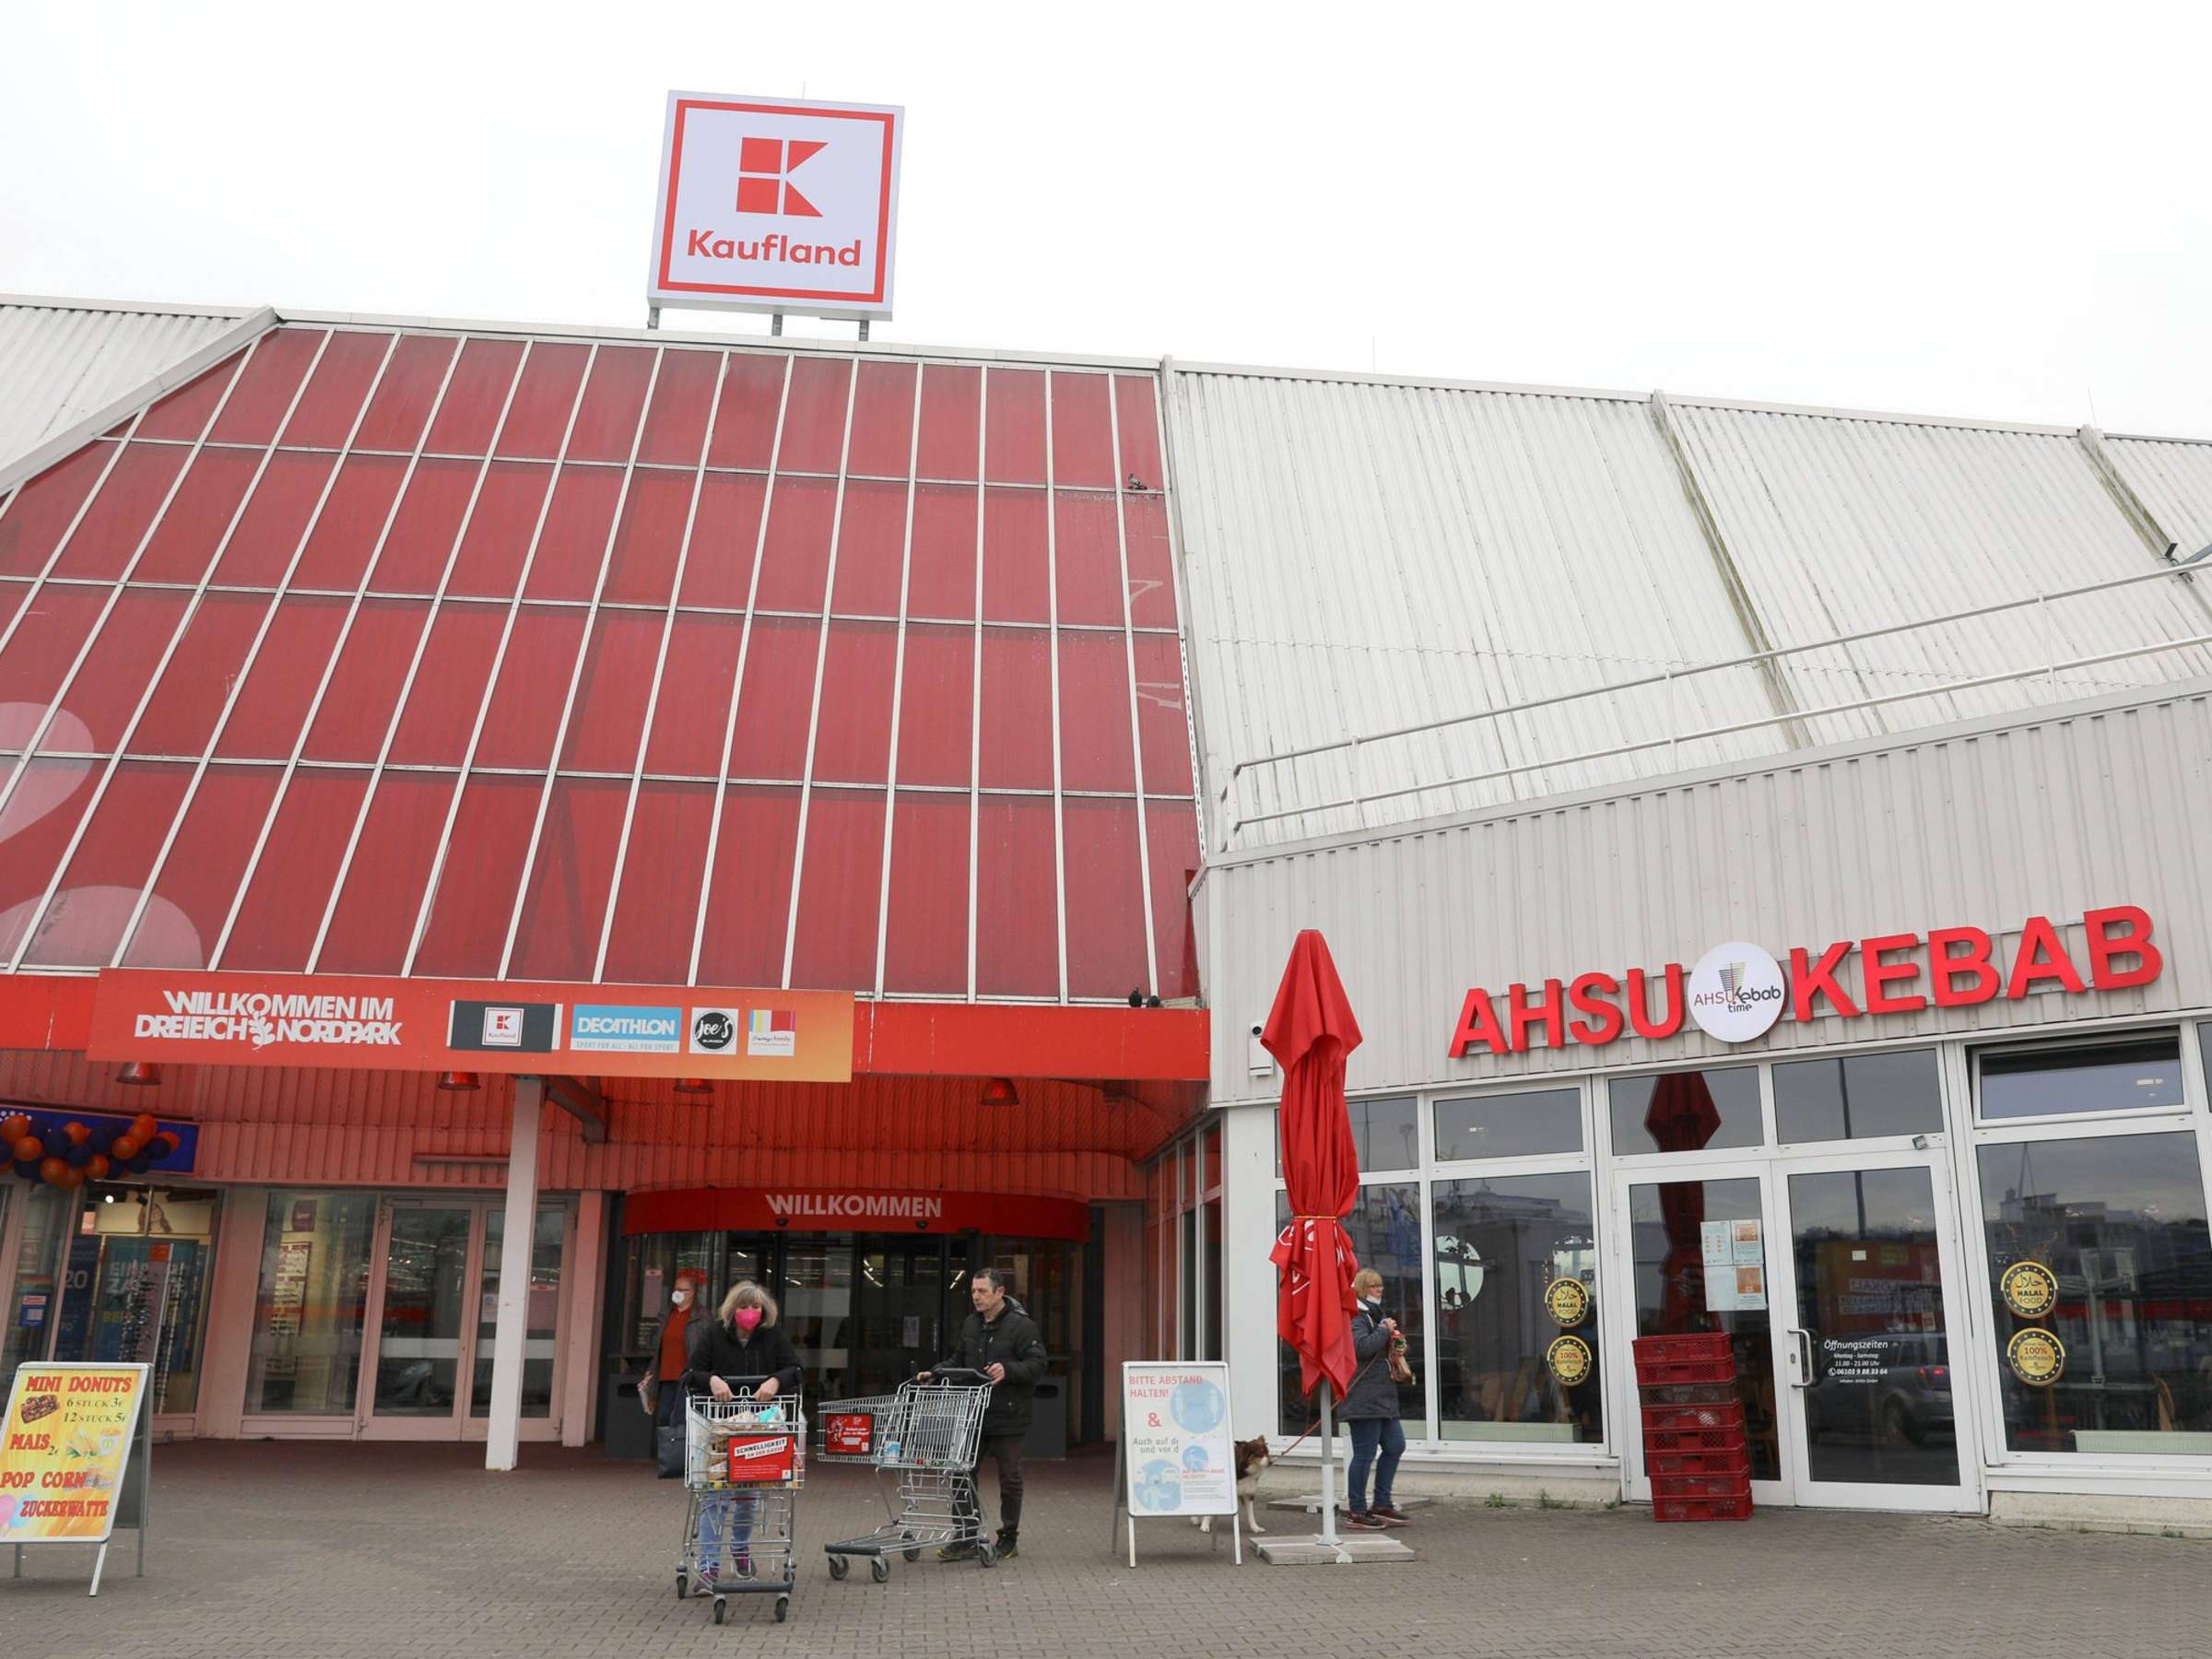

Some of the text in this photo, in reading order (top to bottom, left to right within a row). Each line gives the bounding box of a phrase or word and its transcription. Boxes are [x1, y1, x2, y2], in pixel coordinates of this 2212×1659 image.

[688, 229, 861, 266] Kaufland
[1448, 905, 2163, 1058] AHSU KEBAB
[163, 990, 394, 1020] WILLKOMMEN IM
[1728, 1001, 1752, 1013] time
[135, 1014, 403, 1045] DREIEICH NORDPARK
[577, 1017, 676, 1036] DECATHLON
[765, 1194, 942, 1218] WILLKOMMEN
[1824, 1338, 1888, 1351] Öffnungszeiten
[25, 1376, 132, 1393] MINI DONUTS
[1129, 1375, 1203, 1385] BITTE ABSTAND
[66, 1397, 74, 1407] 6
[1130, 1389, 1170, 1398] HALTEN!
[64, 1412, 77, 1422] 12
[1148, 1412, 1162, 1428] &
[9, 1433, 51, 1451] MAIS
[1133, 1438, 1153, 1446] Auch
[0, 1471, 89, 1489] POP CORN
[19, 1500, 109, 1517] ZUCKERWATTE
